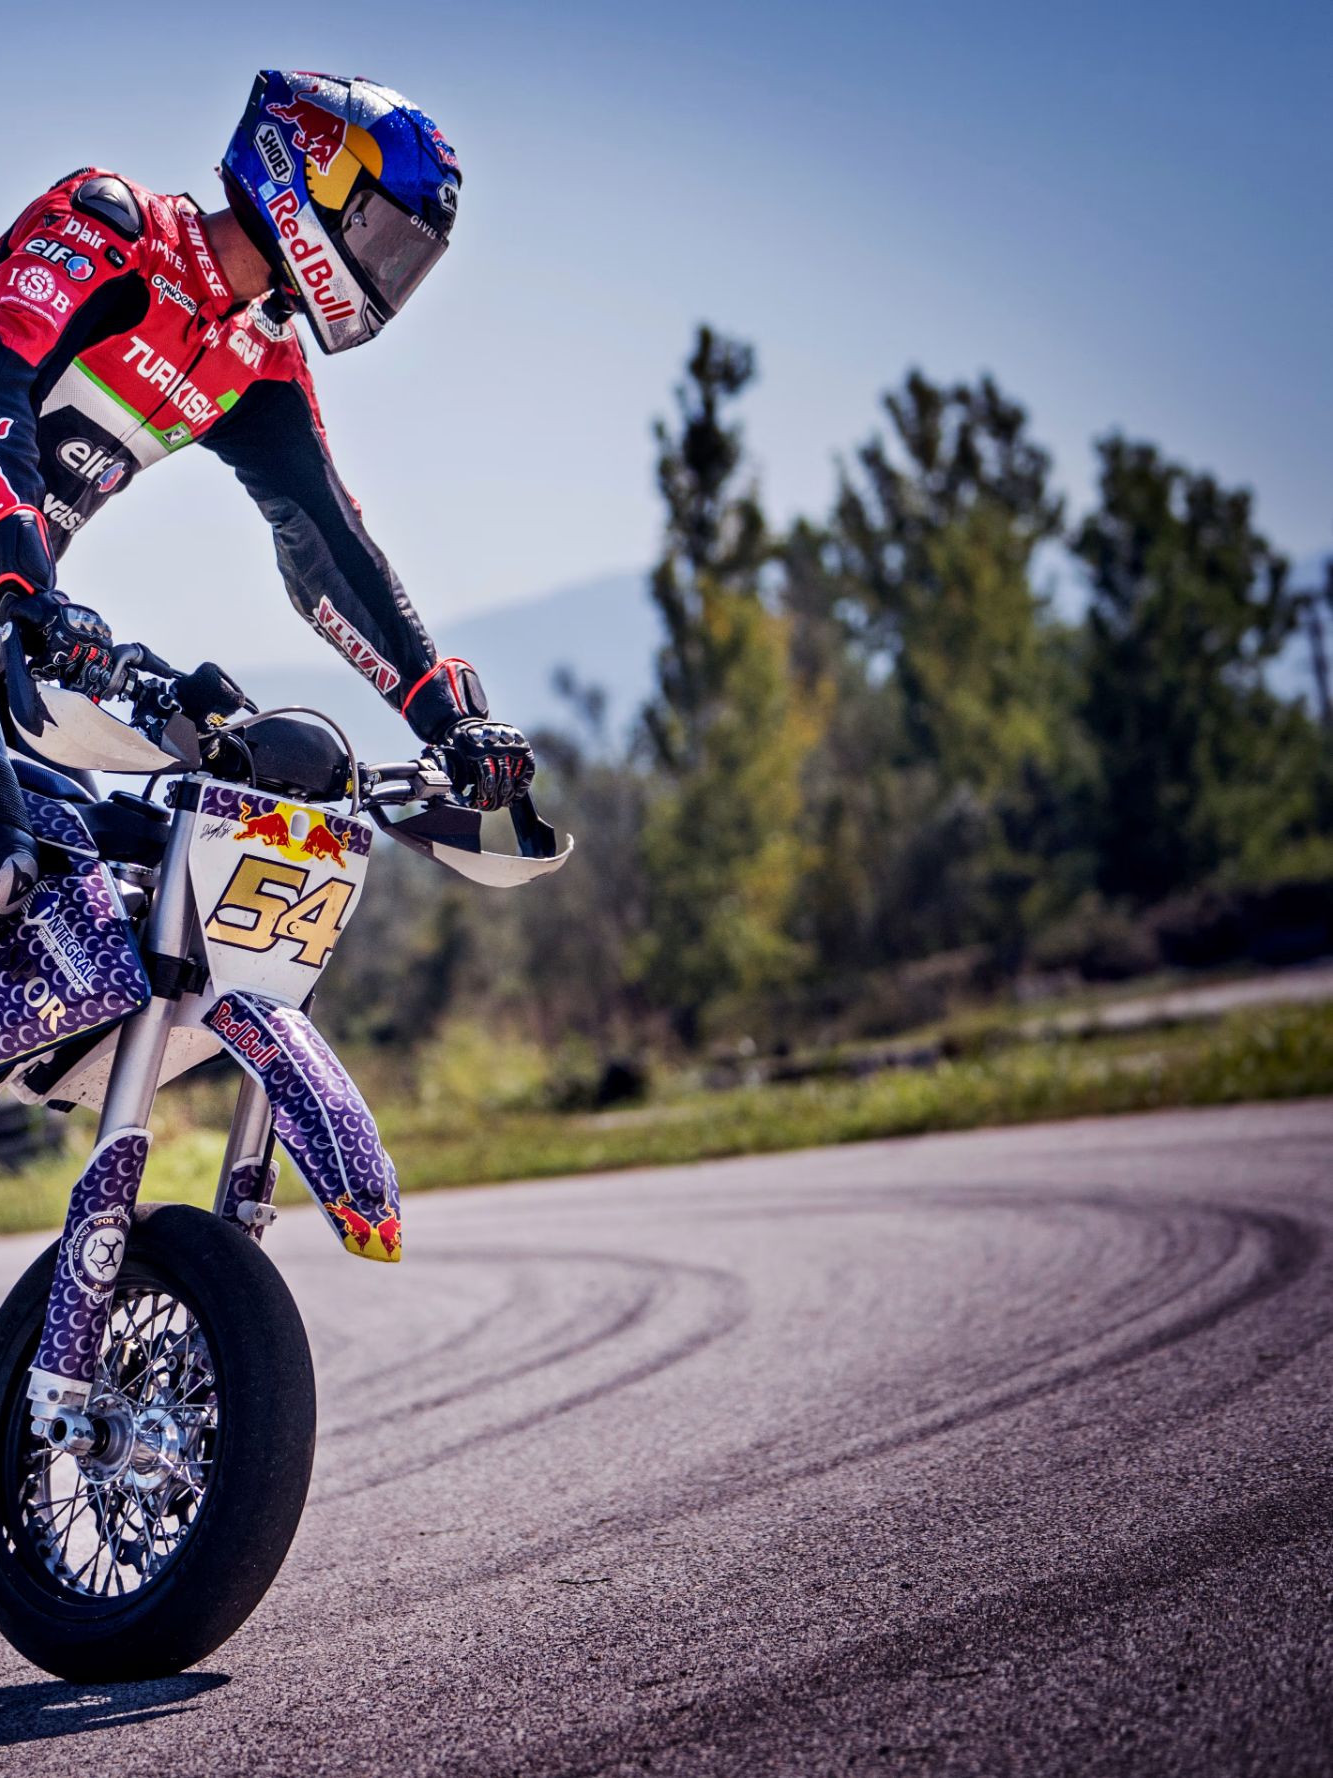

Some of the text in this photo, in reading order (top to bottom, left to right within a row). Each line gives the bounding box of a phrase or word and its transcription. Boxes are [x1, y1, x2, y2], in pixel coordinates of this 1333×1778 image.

[259, 128, 288, 182] SHOEI
[26, 238, 71, 263] elf
[179, 207, 228, 297] DAINESE
[267, 188, 356, 323] Red Bull
[410, 215, 438, 240] GIVES
[122, 336, 219, 424] TURKISH
[205, 853, 356, 968] 54
[208, 999, 281, 1069] Red Bull
[93, 1217, 115, 1226] SPOR
